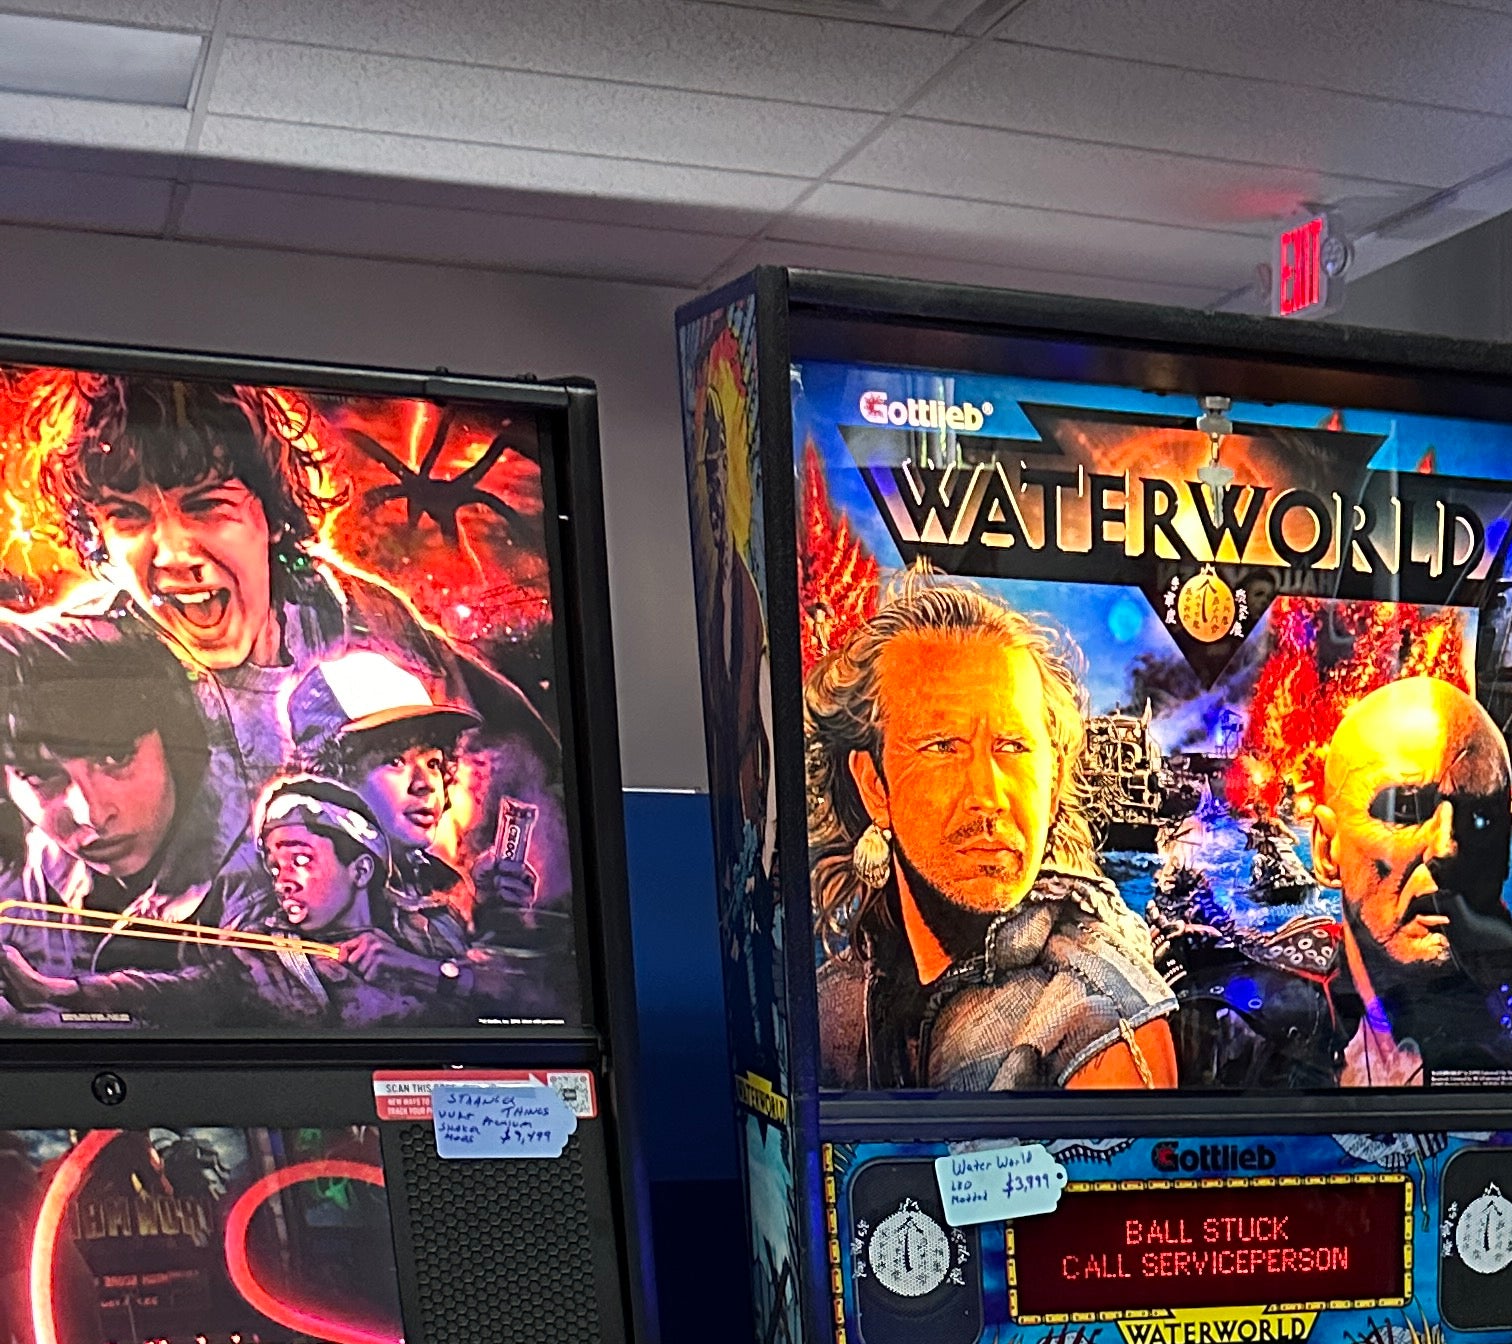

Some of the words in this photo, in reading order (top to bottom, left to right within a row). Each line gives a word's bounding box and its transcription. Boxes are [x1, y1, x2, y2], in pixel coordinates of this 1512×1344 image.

[859, 391, 986, 434] Gottlieb
[896, 456, 1487, 578] WATERWORLD
[386, 1083, 410, 1093] SCAN
[413, 1083, 432, 1093] THIS
[952, 1158, 992, 1176] Water
[996, 1150, 1033, 1169] World
[1151, 1141, 1277, 1173] Gottlieb
[951, 1180, 972, 1192] LED
[1125, 1216, 1190, 1246] BALL
[1202, 1215, 1290, 1244] STUCK
[1062, 1252, 1132, 1280] CALL
[1140, 1245, 1350, 1278] SERVICEPERSON
